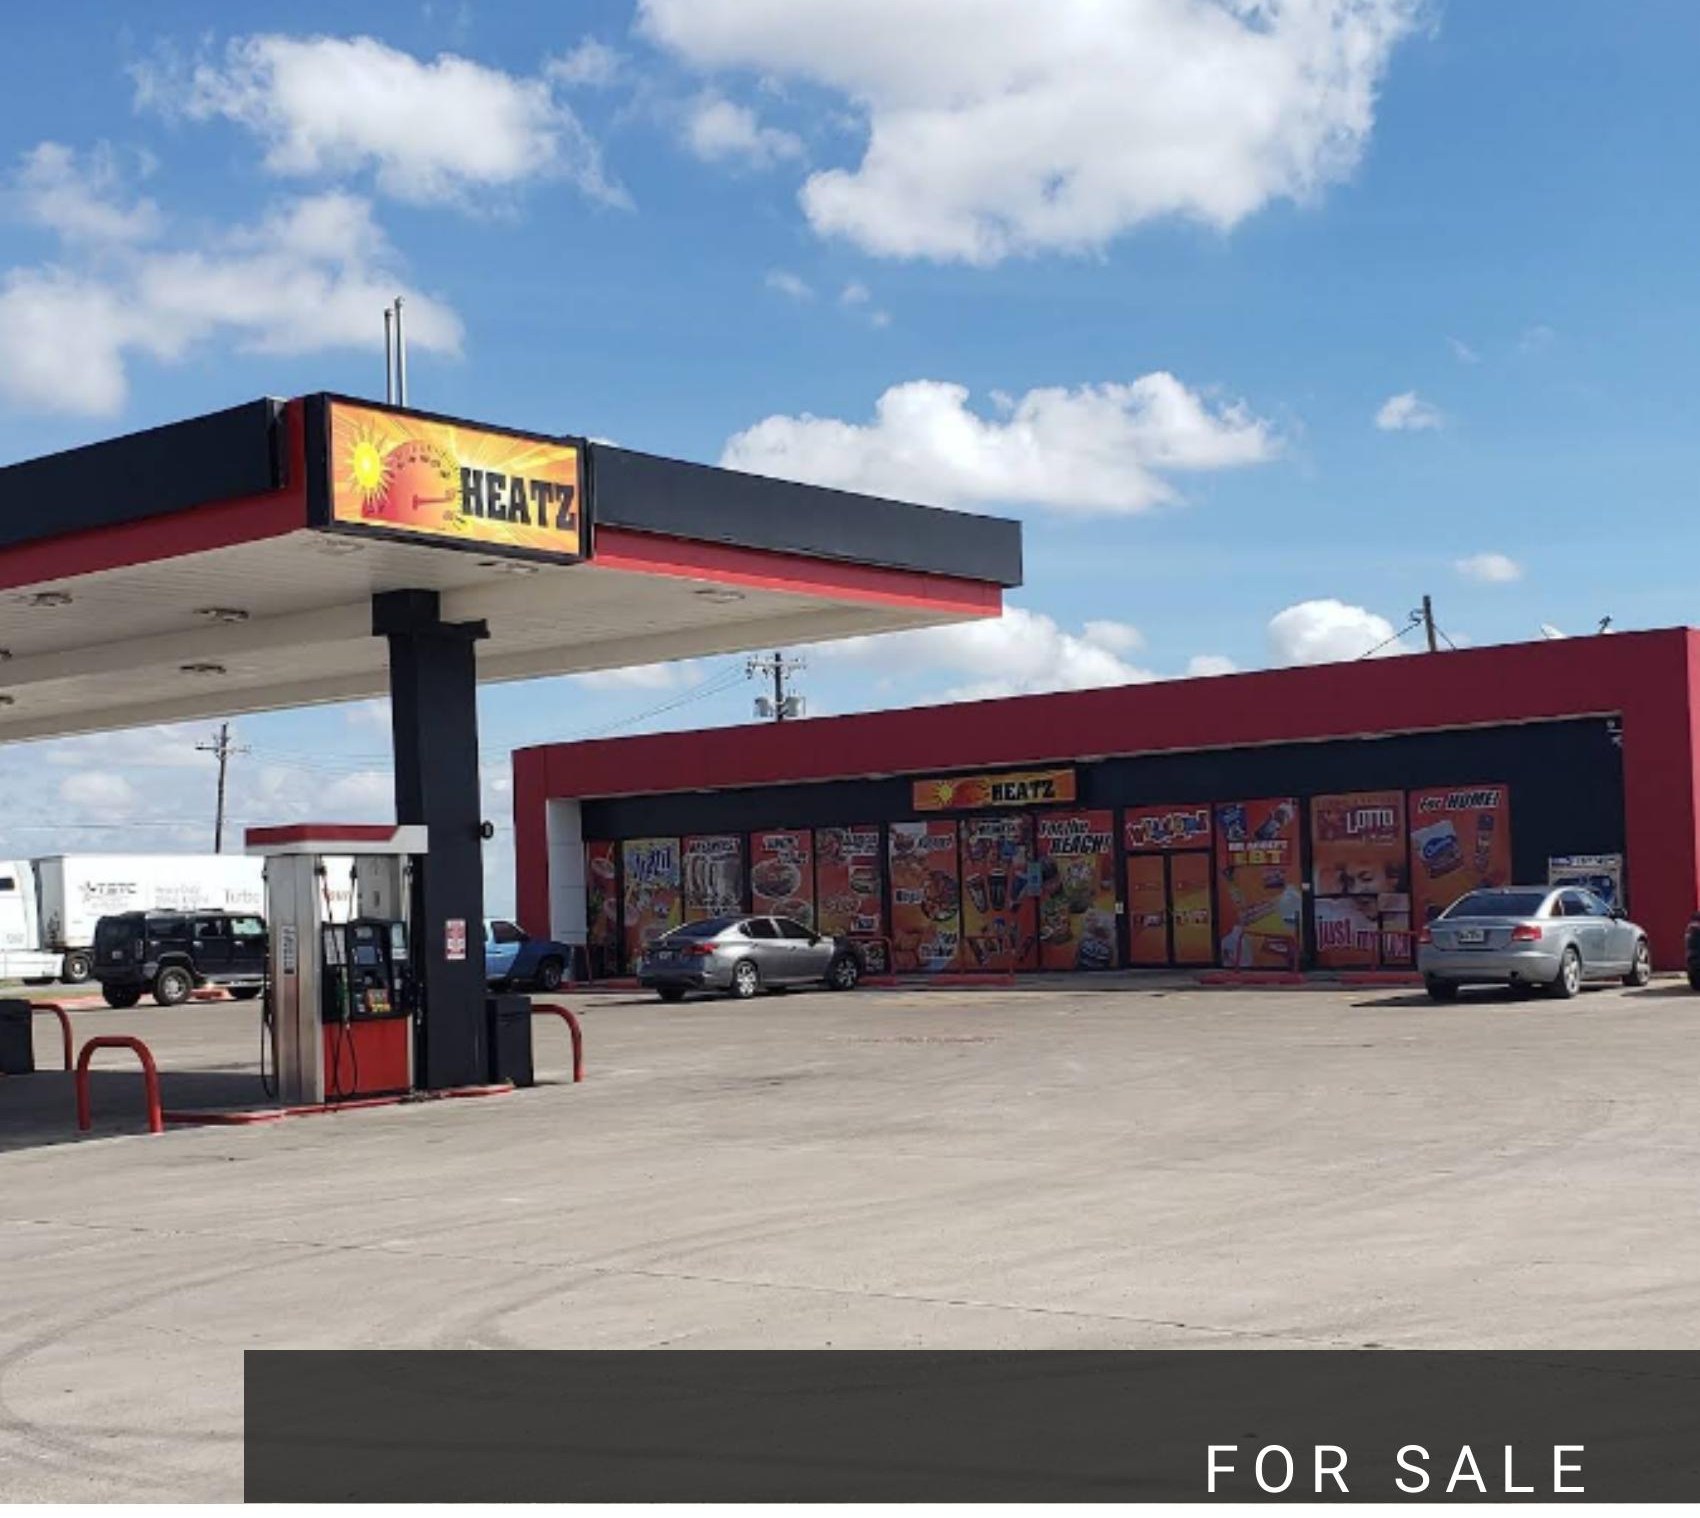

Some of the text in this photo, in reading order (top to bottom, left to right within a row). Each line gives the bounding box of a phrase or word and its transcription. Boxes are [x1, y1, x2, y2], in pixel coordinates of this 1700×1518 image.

[460, 467, 576, 530] HEATZ
[991, 779, 1056, 802] HEATZ
[1347, 809, 1394, 833] LOTTO
[1231, 850, 1282, 865] EBT
